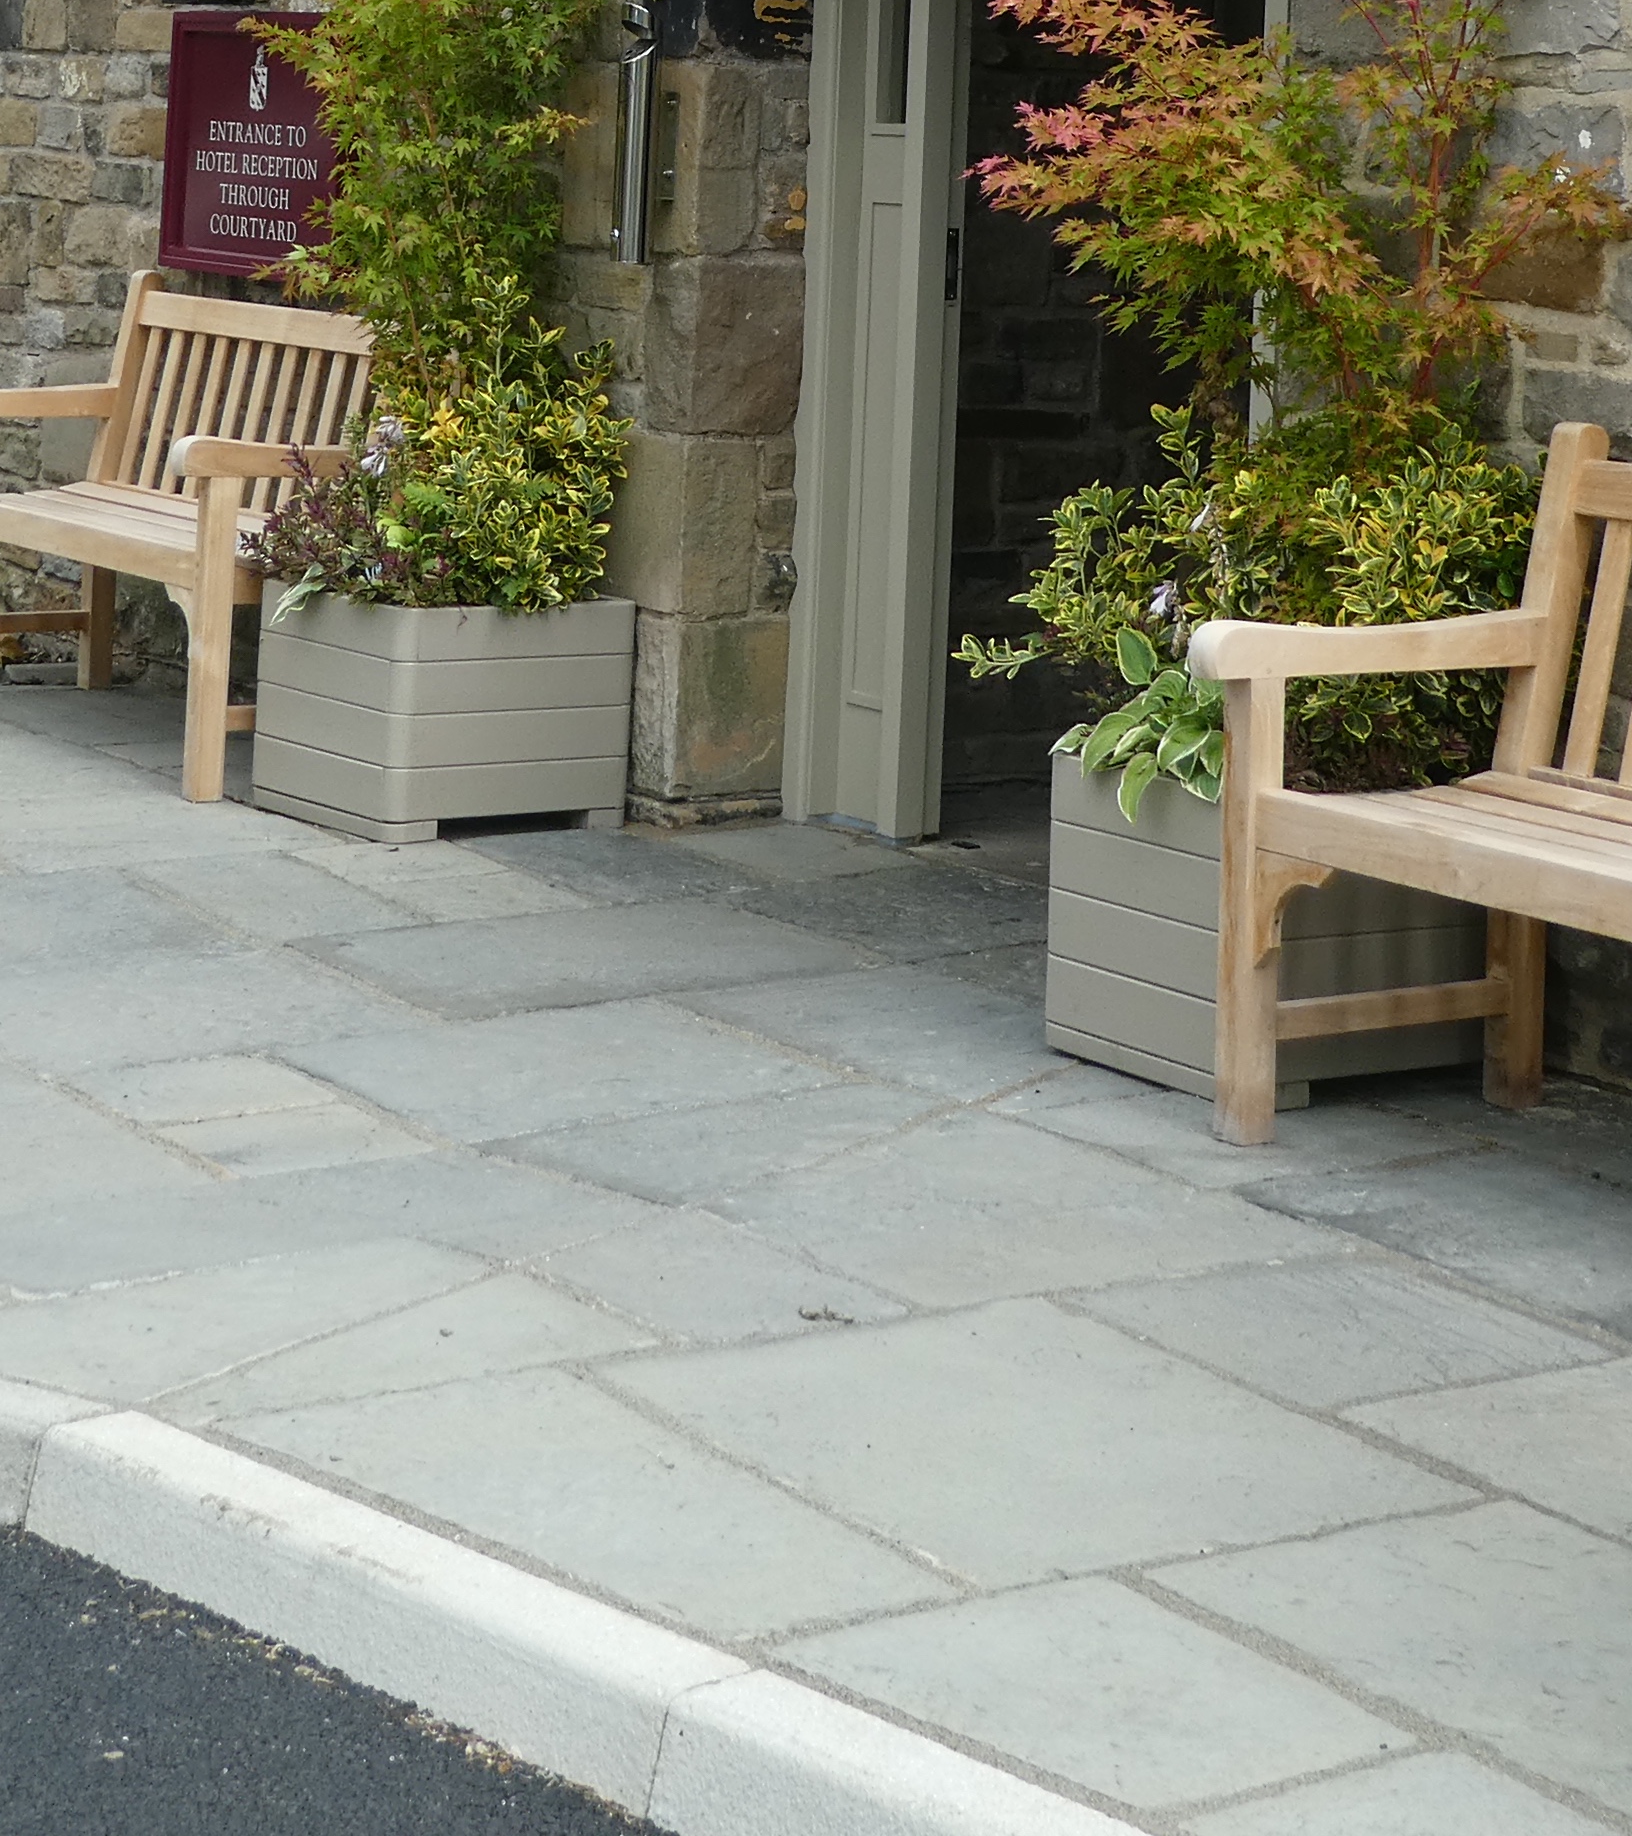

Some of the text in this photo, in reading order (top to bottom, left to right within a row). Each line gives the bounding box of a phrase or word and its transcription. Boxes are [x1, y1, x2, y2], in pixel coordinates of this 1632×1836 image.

[209, 120, 306, 148] ENTRANCE TO
[196, 150, 317, 181] HOTEL RECEPTION
[219, 183, 289, 210] THROUGH
[209, 213, 297, 243] COURTYARD
